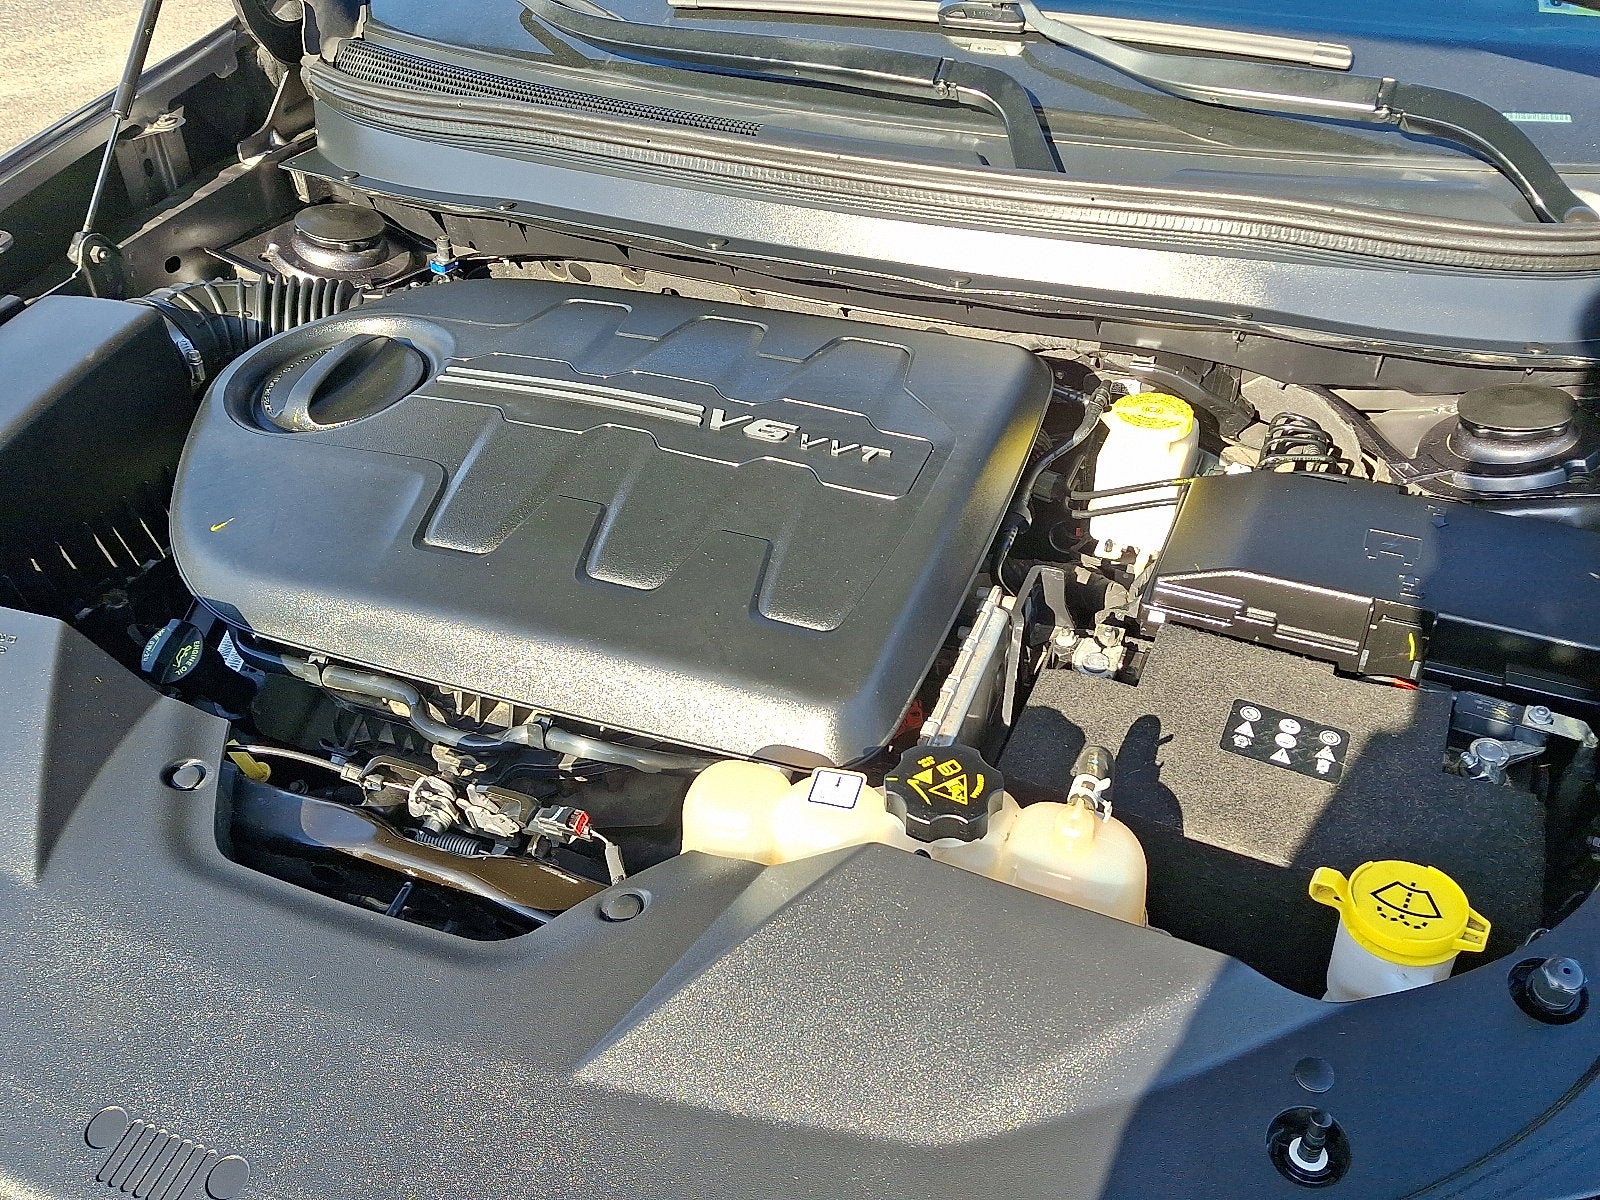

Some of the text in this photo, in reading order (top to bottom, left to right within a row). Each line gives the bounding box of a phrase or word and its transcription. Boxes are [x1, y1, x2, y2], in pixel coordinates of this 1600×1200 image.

[709, 408, 893, 463] V6 VVT
[174, 640, 200, 676] ENGINE OIL
